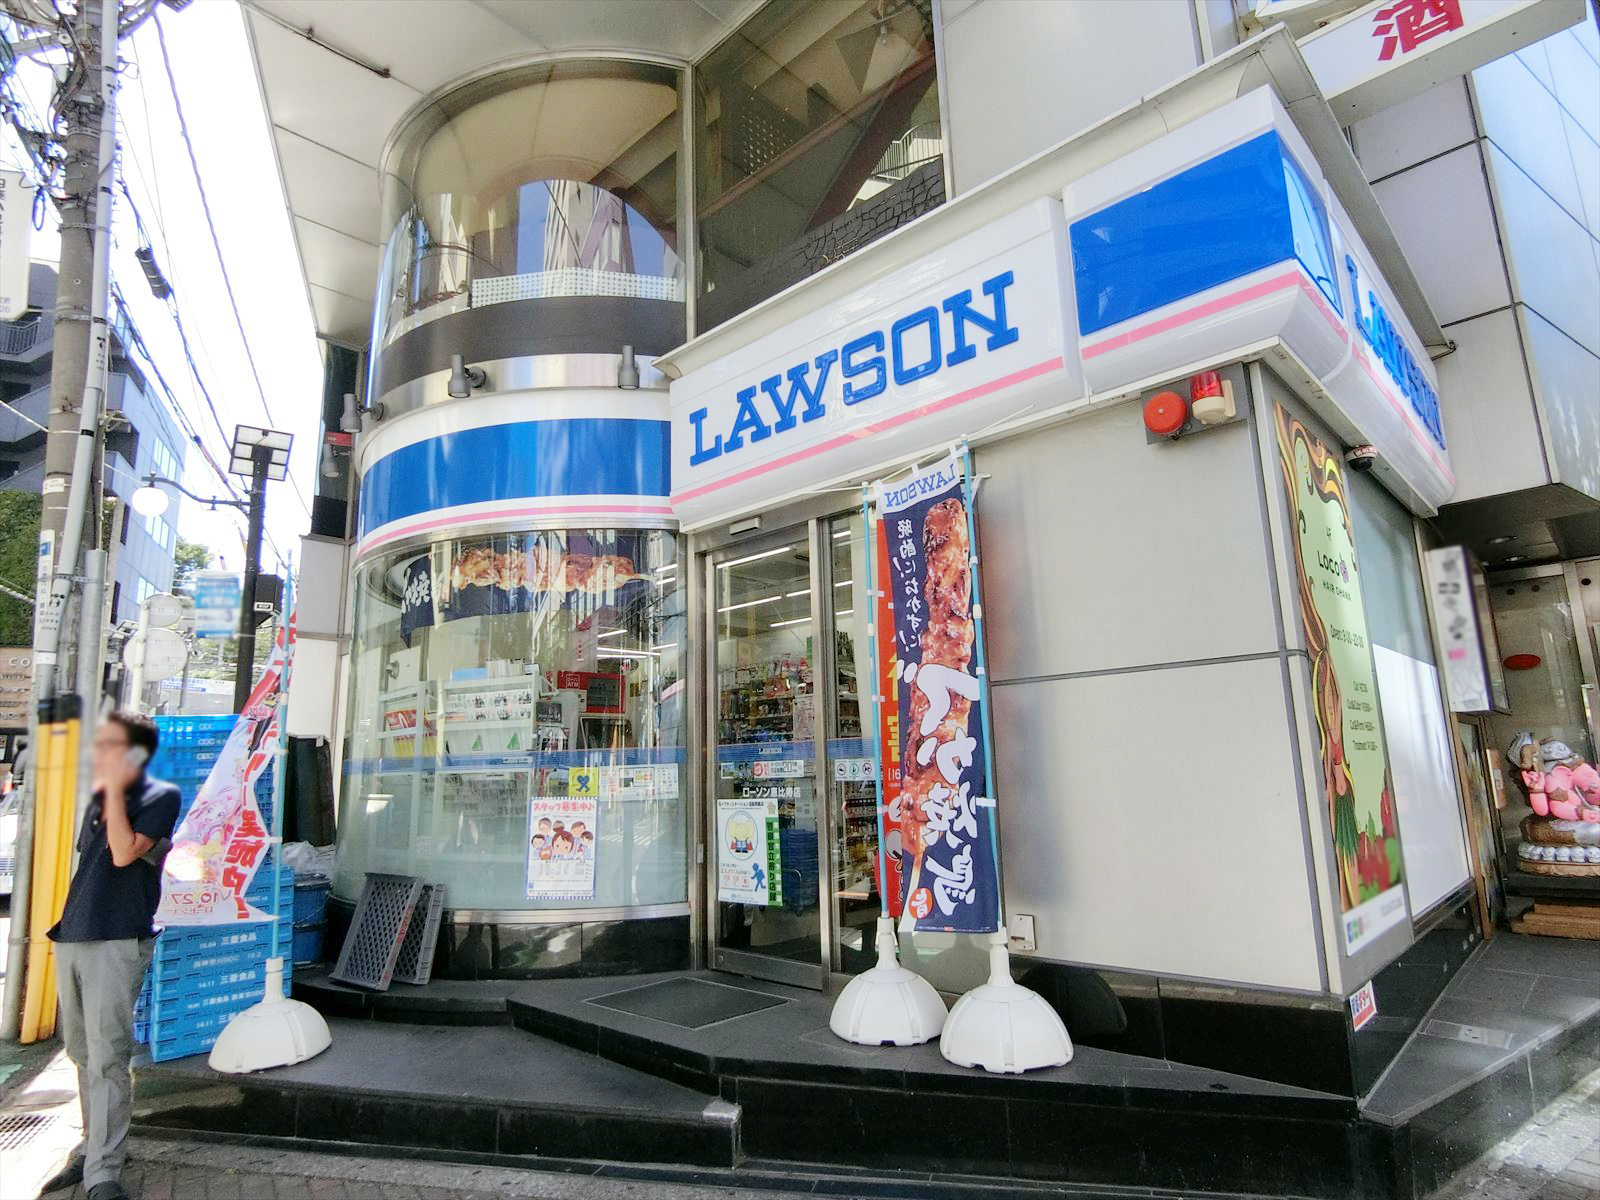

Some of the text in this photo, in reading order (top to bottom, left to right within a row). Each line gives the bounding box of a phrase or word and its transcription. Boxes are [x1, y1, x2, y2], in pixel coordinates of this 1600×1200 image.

[1372, 0, 1464, 61] 酒
[688, 270, 1019, 467] LAWSON
[1317, 550, 1340, 577] LOCO
